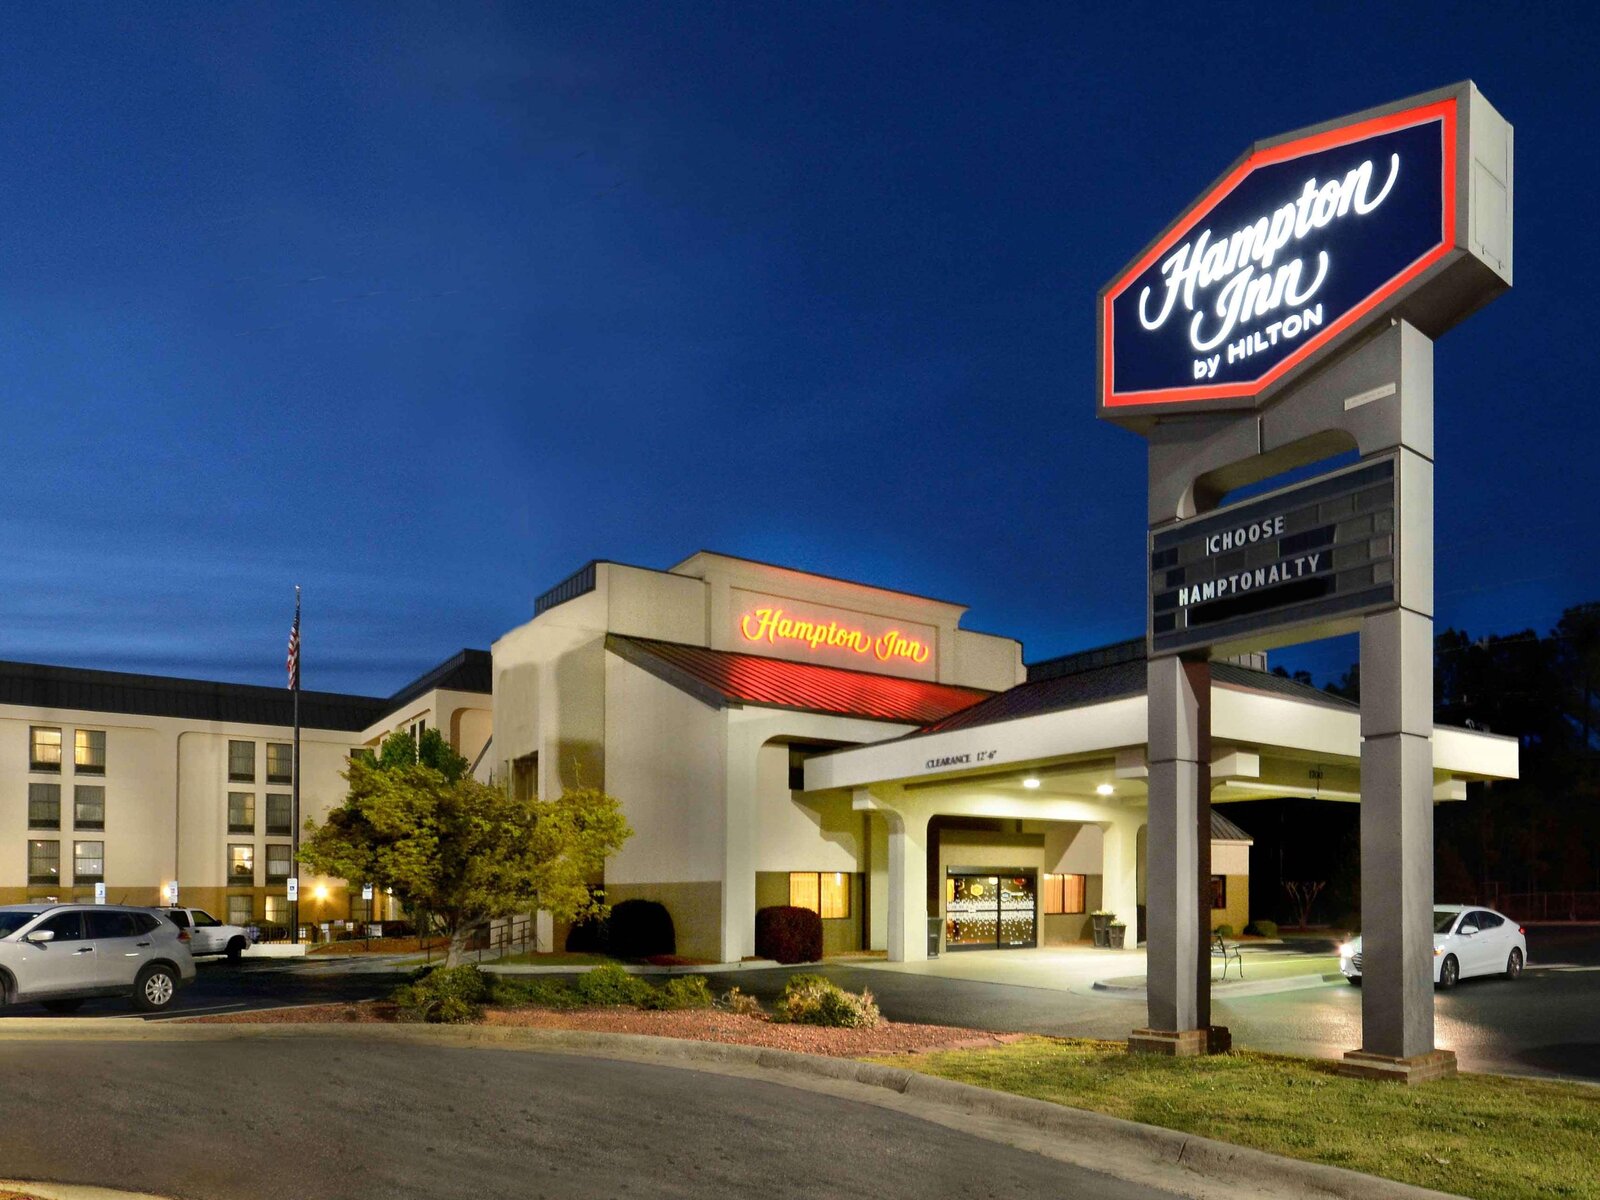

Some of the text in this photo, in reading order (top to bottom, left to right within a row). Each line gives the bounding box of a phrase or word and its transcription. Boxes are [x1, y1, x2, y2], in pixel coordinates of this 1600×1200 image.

[1139, 153, 1399, 330] Hampton
[1190, 251, 1328, 351] Inn
[1194, 304, 1323, 379] by HILTON
[1178, 554, 1320, 607] HAMPTONALTY
[742, 608, 929, 662] Hampton Inn
[926, 754, 971, 769] CLEARANCE
